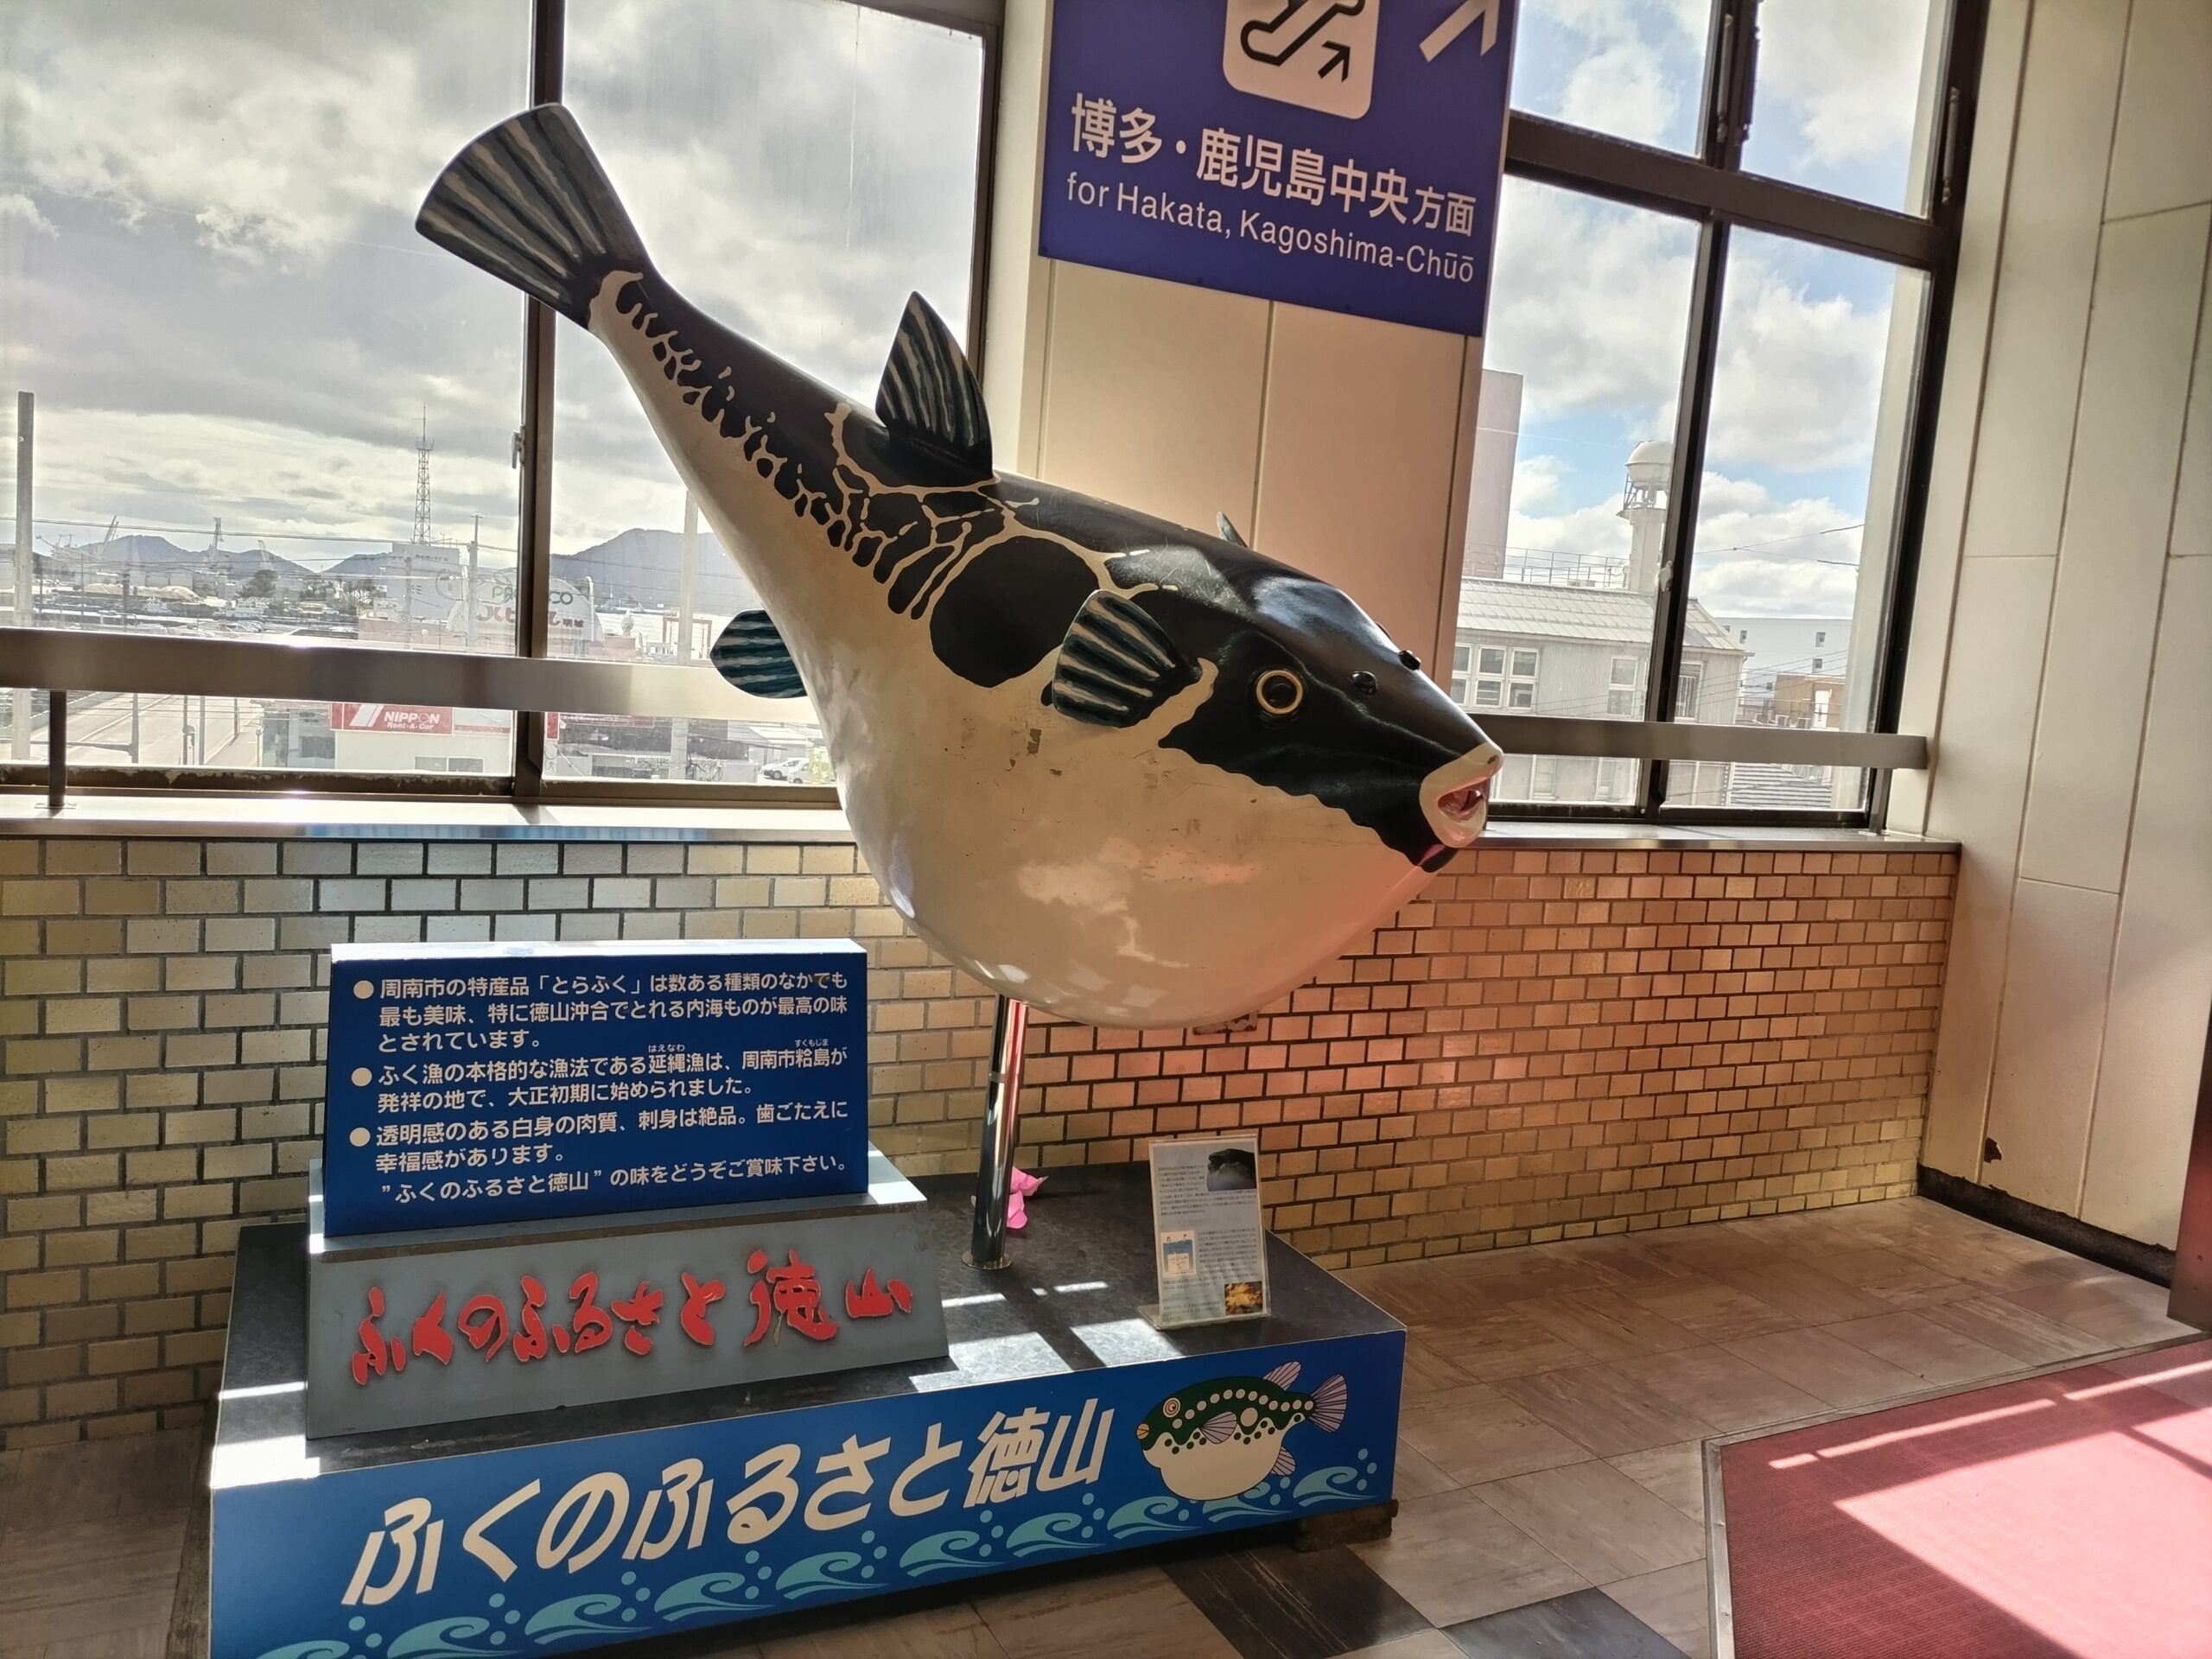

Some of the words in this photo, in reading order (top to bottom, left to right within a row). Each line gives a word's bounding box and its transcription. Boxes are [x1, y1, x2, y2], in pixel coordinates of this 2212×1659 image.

[1071, 92, 1476, 236] 博多・鹿児島中央方面
[1067, 171, 1109, 207] for
[1117, 182, 1230, 238] Hakata,
[1240, 209, 1474, 283] Kagoshima-Chūō
[384, 711, 440, 724] NIPPON
[380, 971, 848, 999] 周南市の特産品「とらふく」は数ある種類のなかでも
[379, 995, 848, 1027] 最も美味、特に徳山沖合でとれる内海ものが最高の味
[378, 1029, 540, 1053] とされています。
[648, 1044, 685, 1053] はえなわ
[794, 1039, 830, 1048] すくもじま
[378, 1077, 751, 1113] 発祥の地で、大正初期に始められました。
[376, 1101, 848, 1146] 透明感のある白身の肉質、刺身は絶品。歯ごたえに
[376, 1143, 563, 1173] 幸福感があります。
[341, 1396, 1116, 1605] ふくのふるさと徳山
